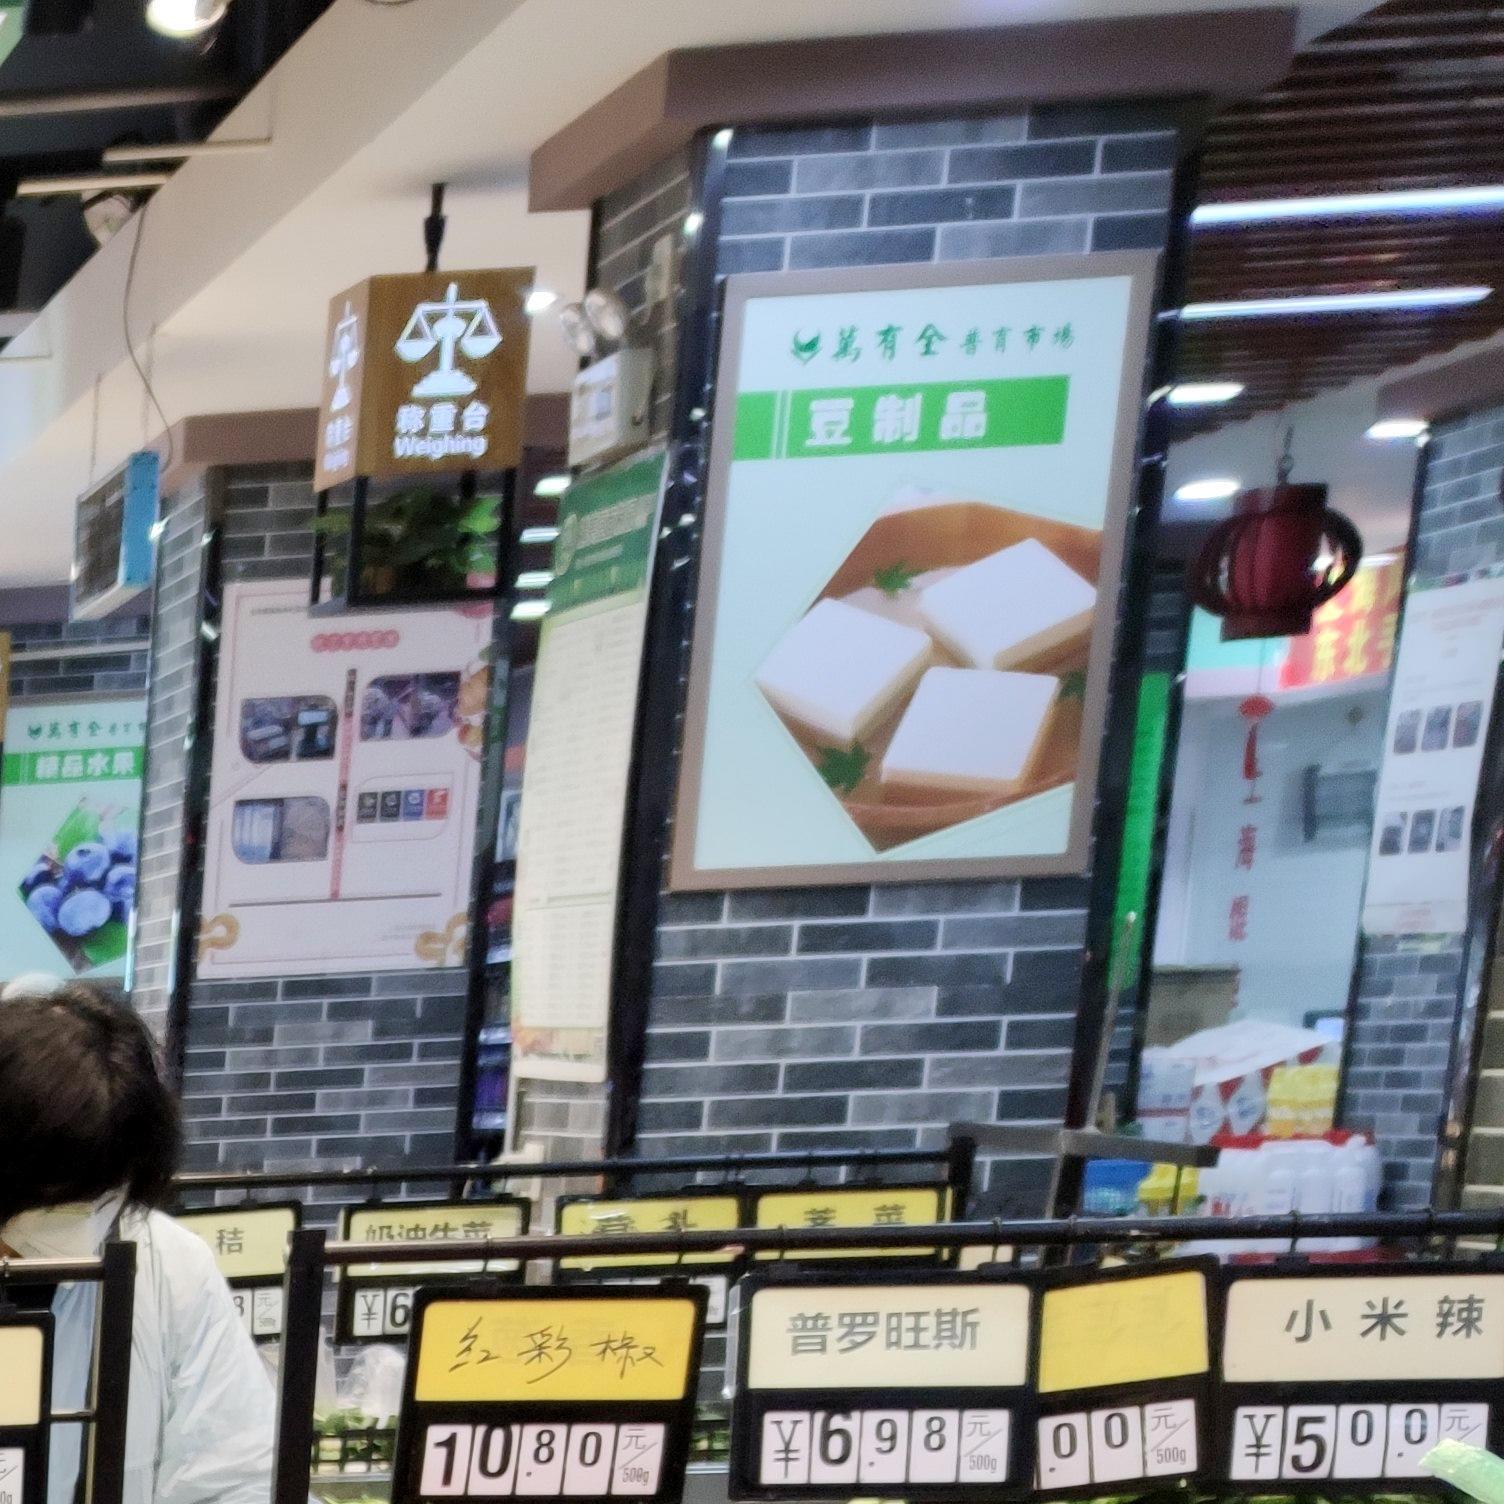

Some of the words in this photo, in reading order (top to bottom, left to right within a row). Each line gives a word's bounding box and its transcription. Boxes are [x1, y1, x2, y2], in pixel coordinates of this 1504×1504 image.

[394, 433, 488, 461] Weighing
[805, 390, 987, 447] 豆制品
[787, 1307, 982, 1355] 普罗旺斯
[1283, 1293, 1486, 1344] 小米辣
[448, 1316, 664, 1384] 红彩椒
[434, 1426, 601, 1488] 10.80
[772, 1412, 947, 1480] ¥6.98
